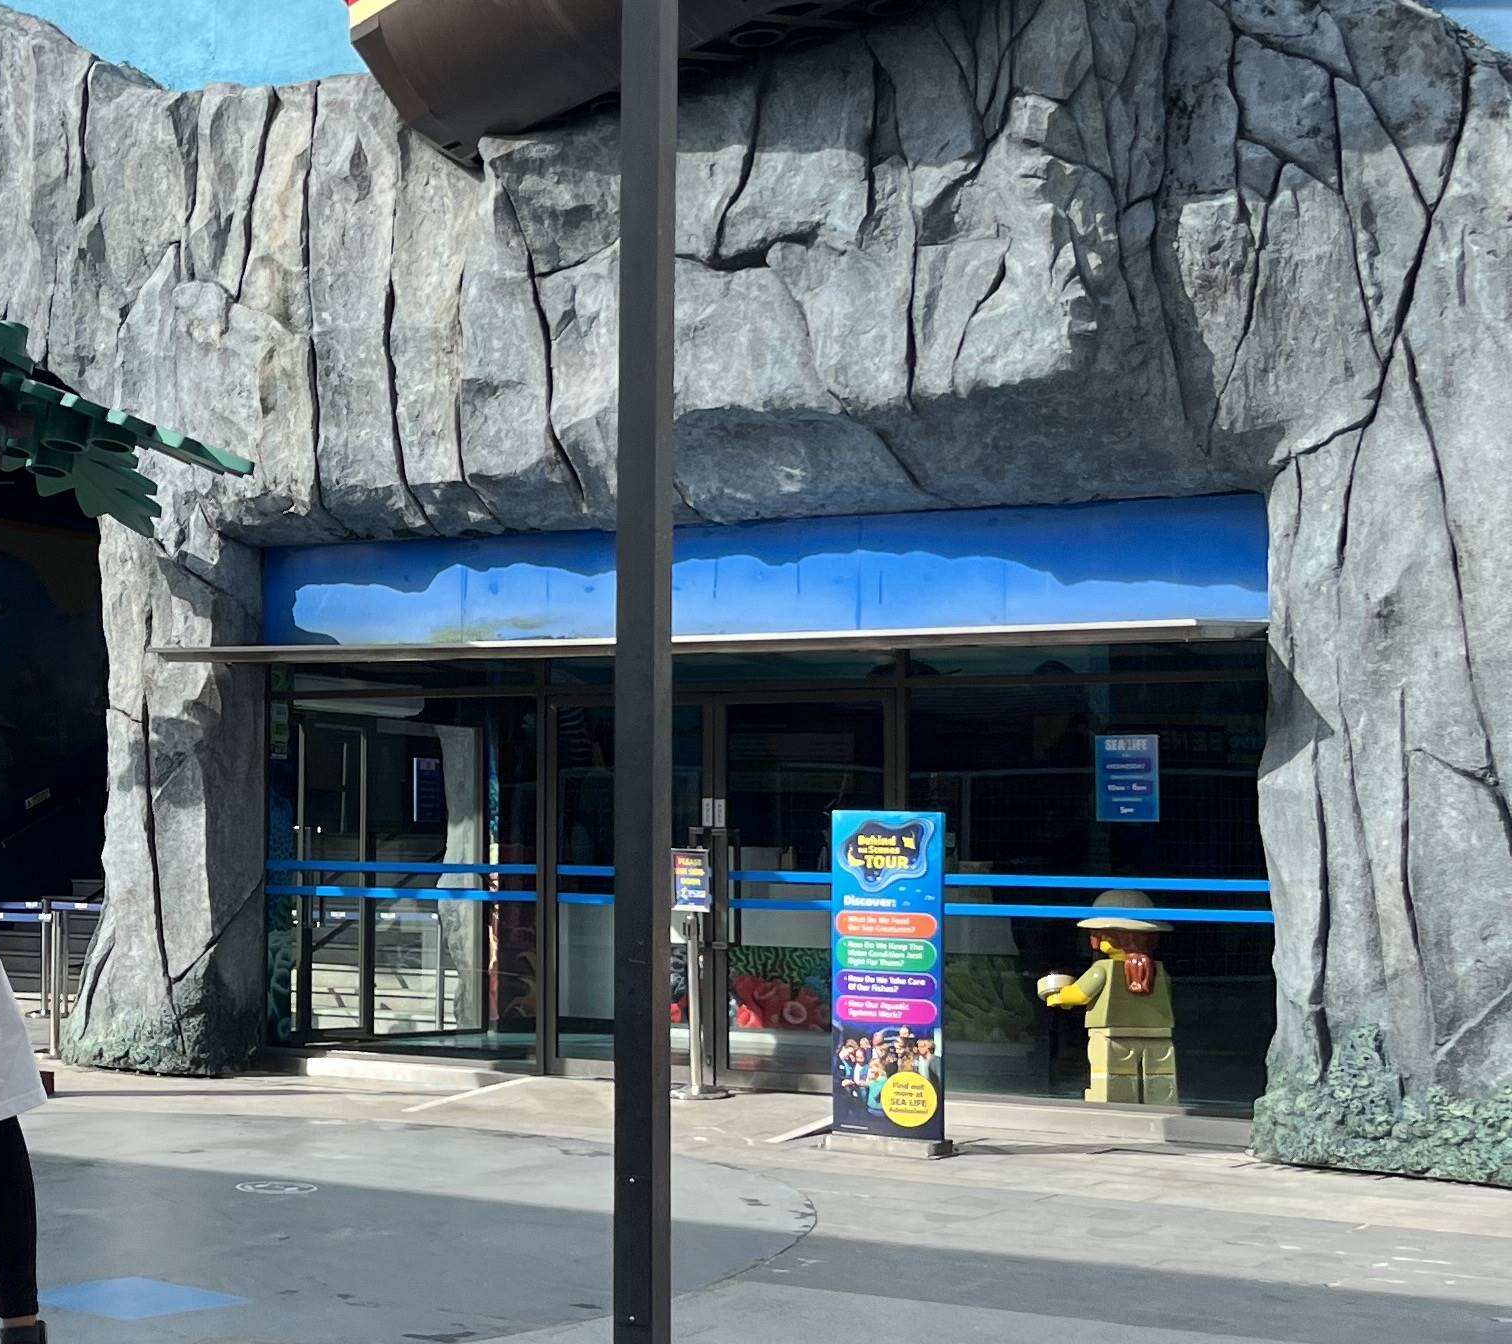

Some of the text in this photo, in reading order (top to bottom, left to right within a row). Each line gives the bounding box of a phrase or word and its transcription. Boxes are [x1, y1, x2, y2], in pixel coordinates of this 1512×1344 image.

[1105, 739, 1125, 751] SEA
[1127, 739, 1148, 751] LIFE
[864, 854, 909, 869] TOUR
[843, 894, 897, 908] Discover:
[864, 975, 875, 983] Do
[907, 977, 926, 986] Care
